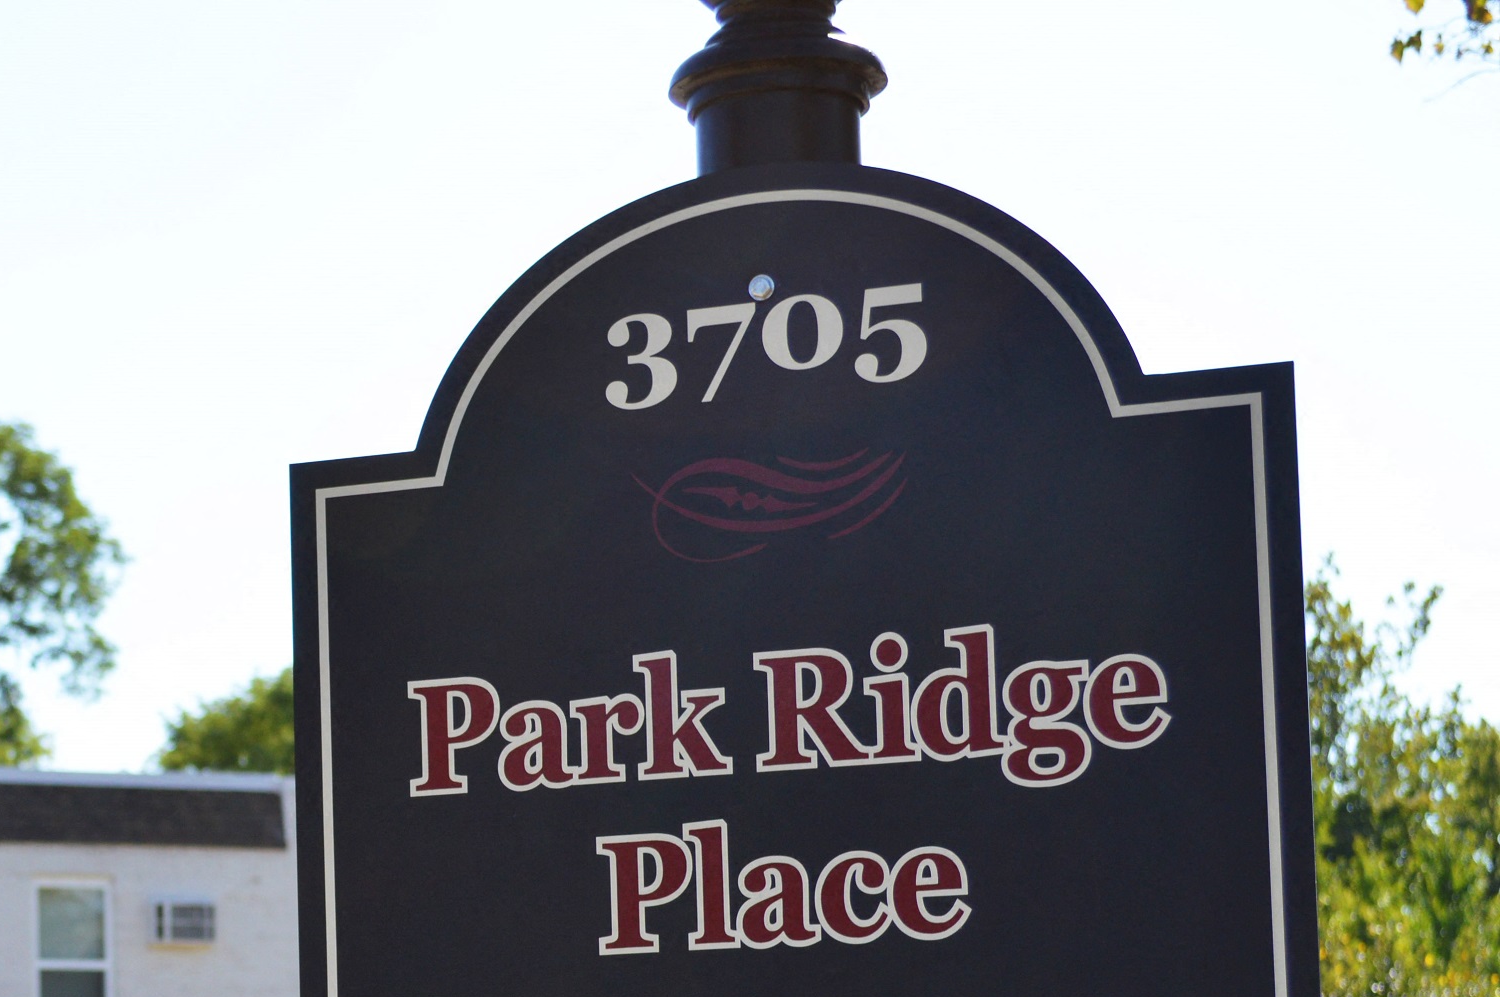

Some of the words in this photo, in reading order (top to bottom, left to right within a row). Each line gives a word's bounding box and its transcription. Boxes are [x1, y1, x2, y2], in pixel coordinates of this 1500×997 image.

[605, 282, 929, 411] 3705
[406, 649, 734, 798] Park
[753, 623, 1172, 788] Ridge
[596, 818, 973, 956] Place
